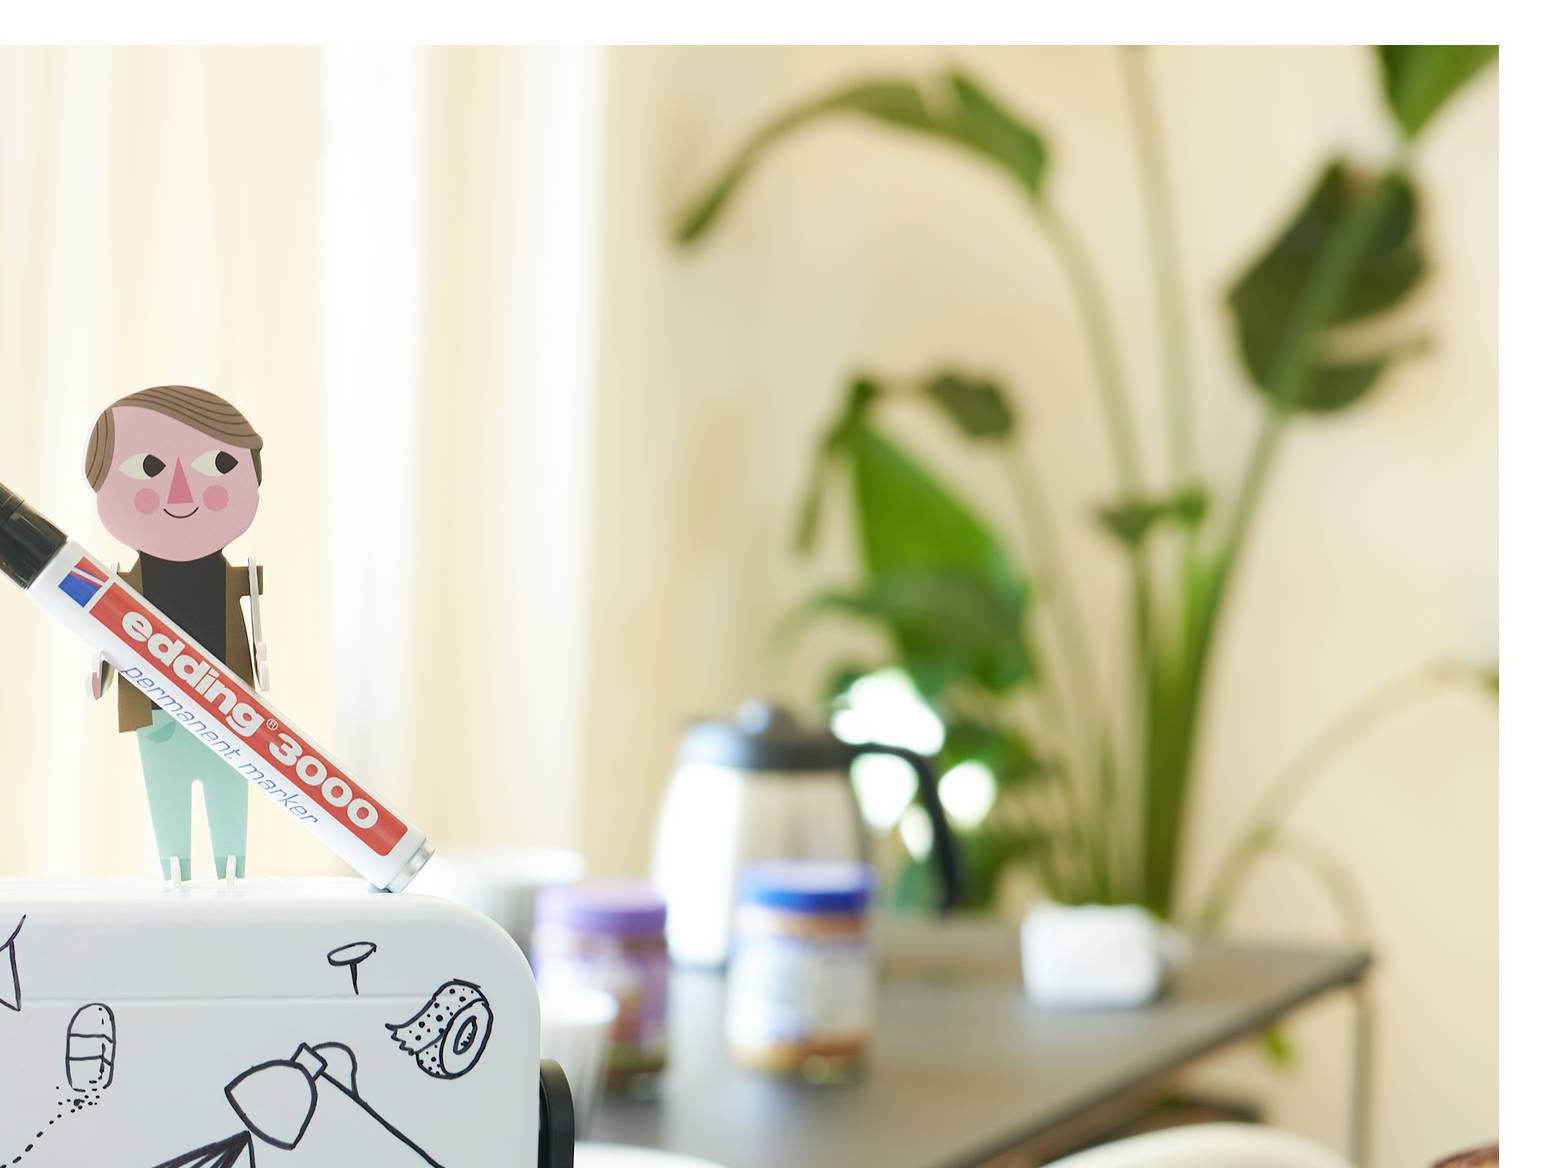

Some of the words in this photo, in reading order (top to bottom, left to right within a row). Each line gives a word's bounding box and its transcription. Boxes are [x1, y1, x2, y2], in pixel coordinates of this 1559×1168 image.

[120, 666, 240, 760] permanent
[239, 763, 319, 823] marker
[269, 732, 379, 829] 3000
